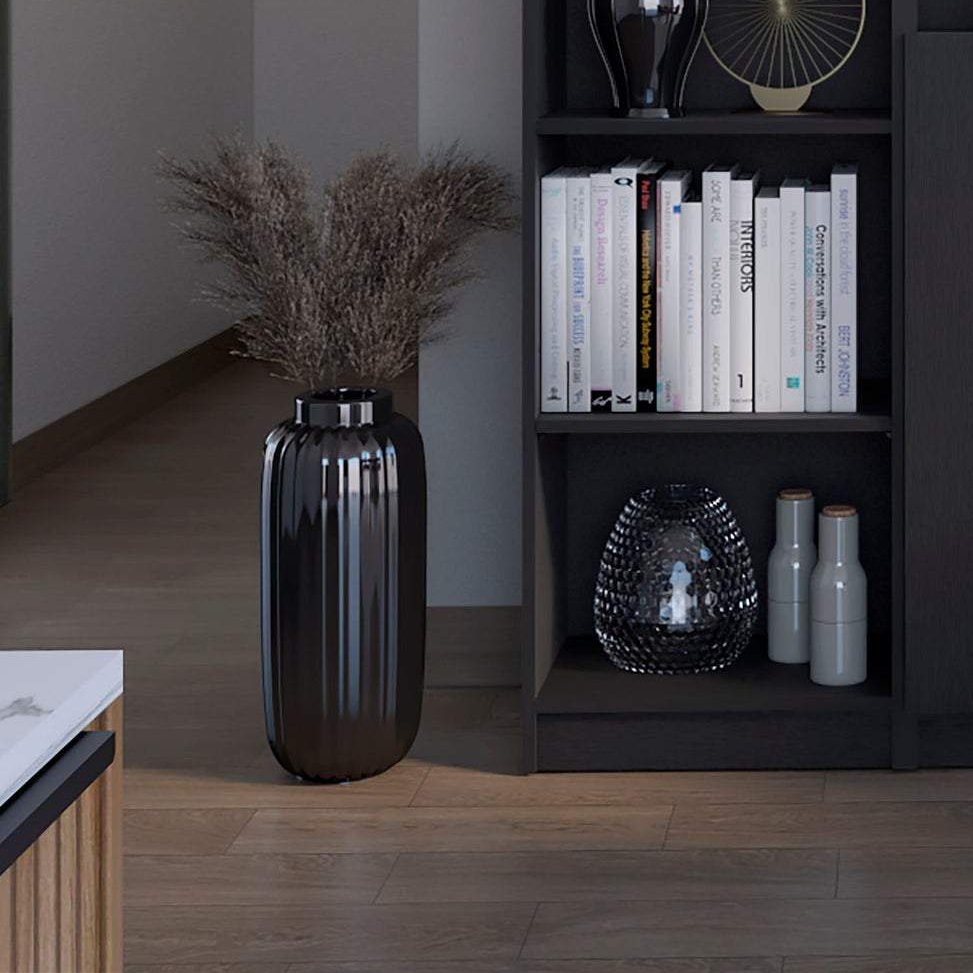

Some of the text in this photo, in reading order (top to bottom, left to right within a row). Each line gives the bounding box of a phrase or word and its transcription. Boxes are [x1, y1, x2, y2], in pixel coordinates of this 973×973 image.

[640, 180, 650, 193] Paul
[710, 180, 722, 223] SOME ARE
[838, 189, 850, 220] sunrise
[596, 199, 608, 285] Design Research
[740, 220, 753, 293] INTERIORS
[838, 232, 850, 244] the
[838, 247, 850, 269] cloud
[572, 257, 584, 299] BLUEPRINT
[618, 196, 630, 348] ESSENTIALS OF VISUAL COMMUNICATION
[710, 256, 722, 315] THAN OTHERS
[838, 271, 850, 295] forest
[640, 230, 652, 369] Helvetica and the New York City Subway System
[815, 224, 827, 374] Conversations with Architects
[572, 315, 584, 344] SUCCESS
[838, 326, 851, 397] BERT JOHNSTON
